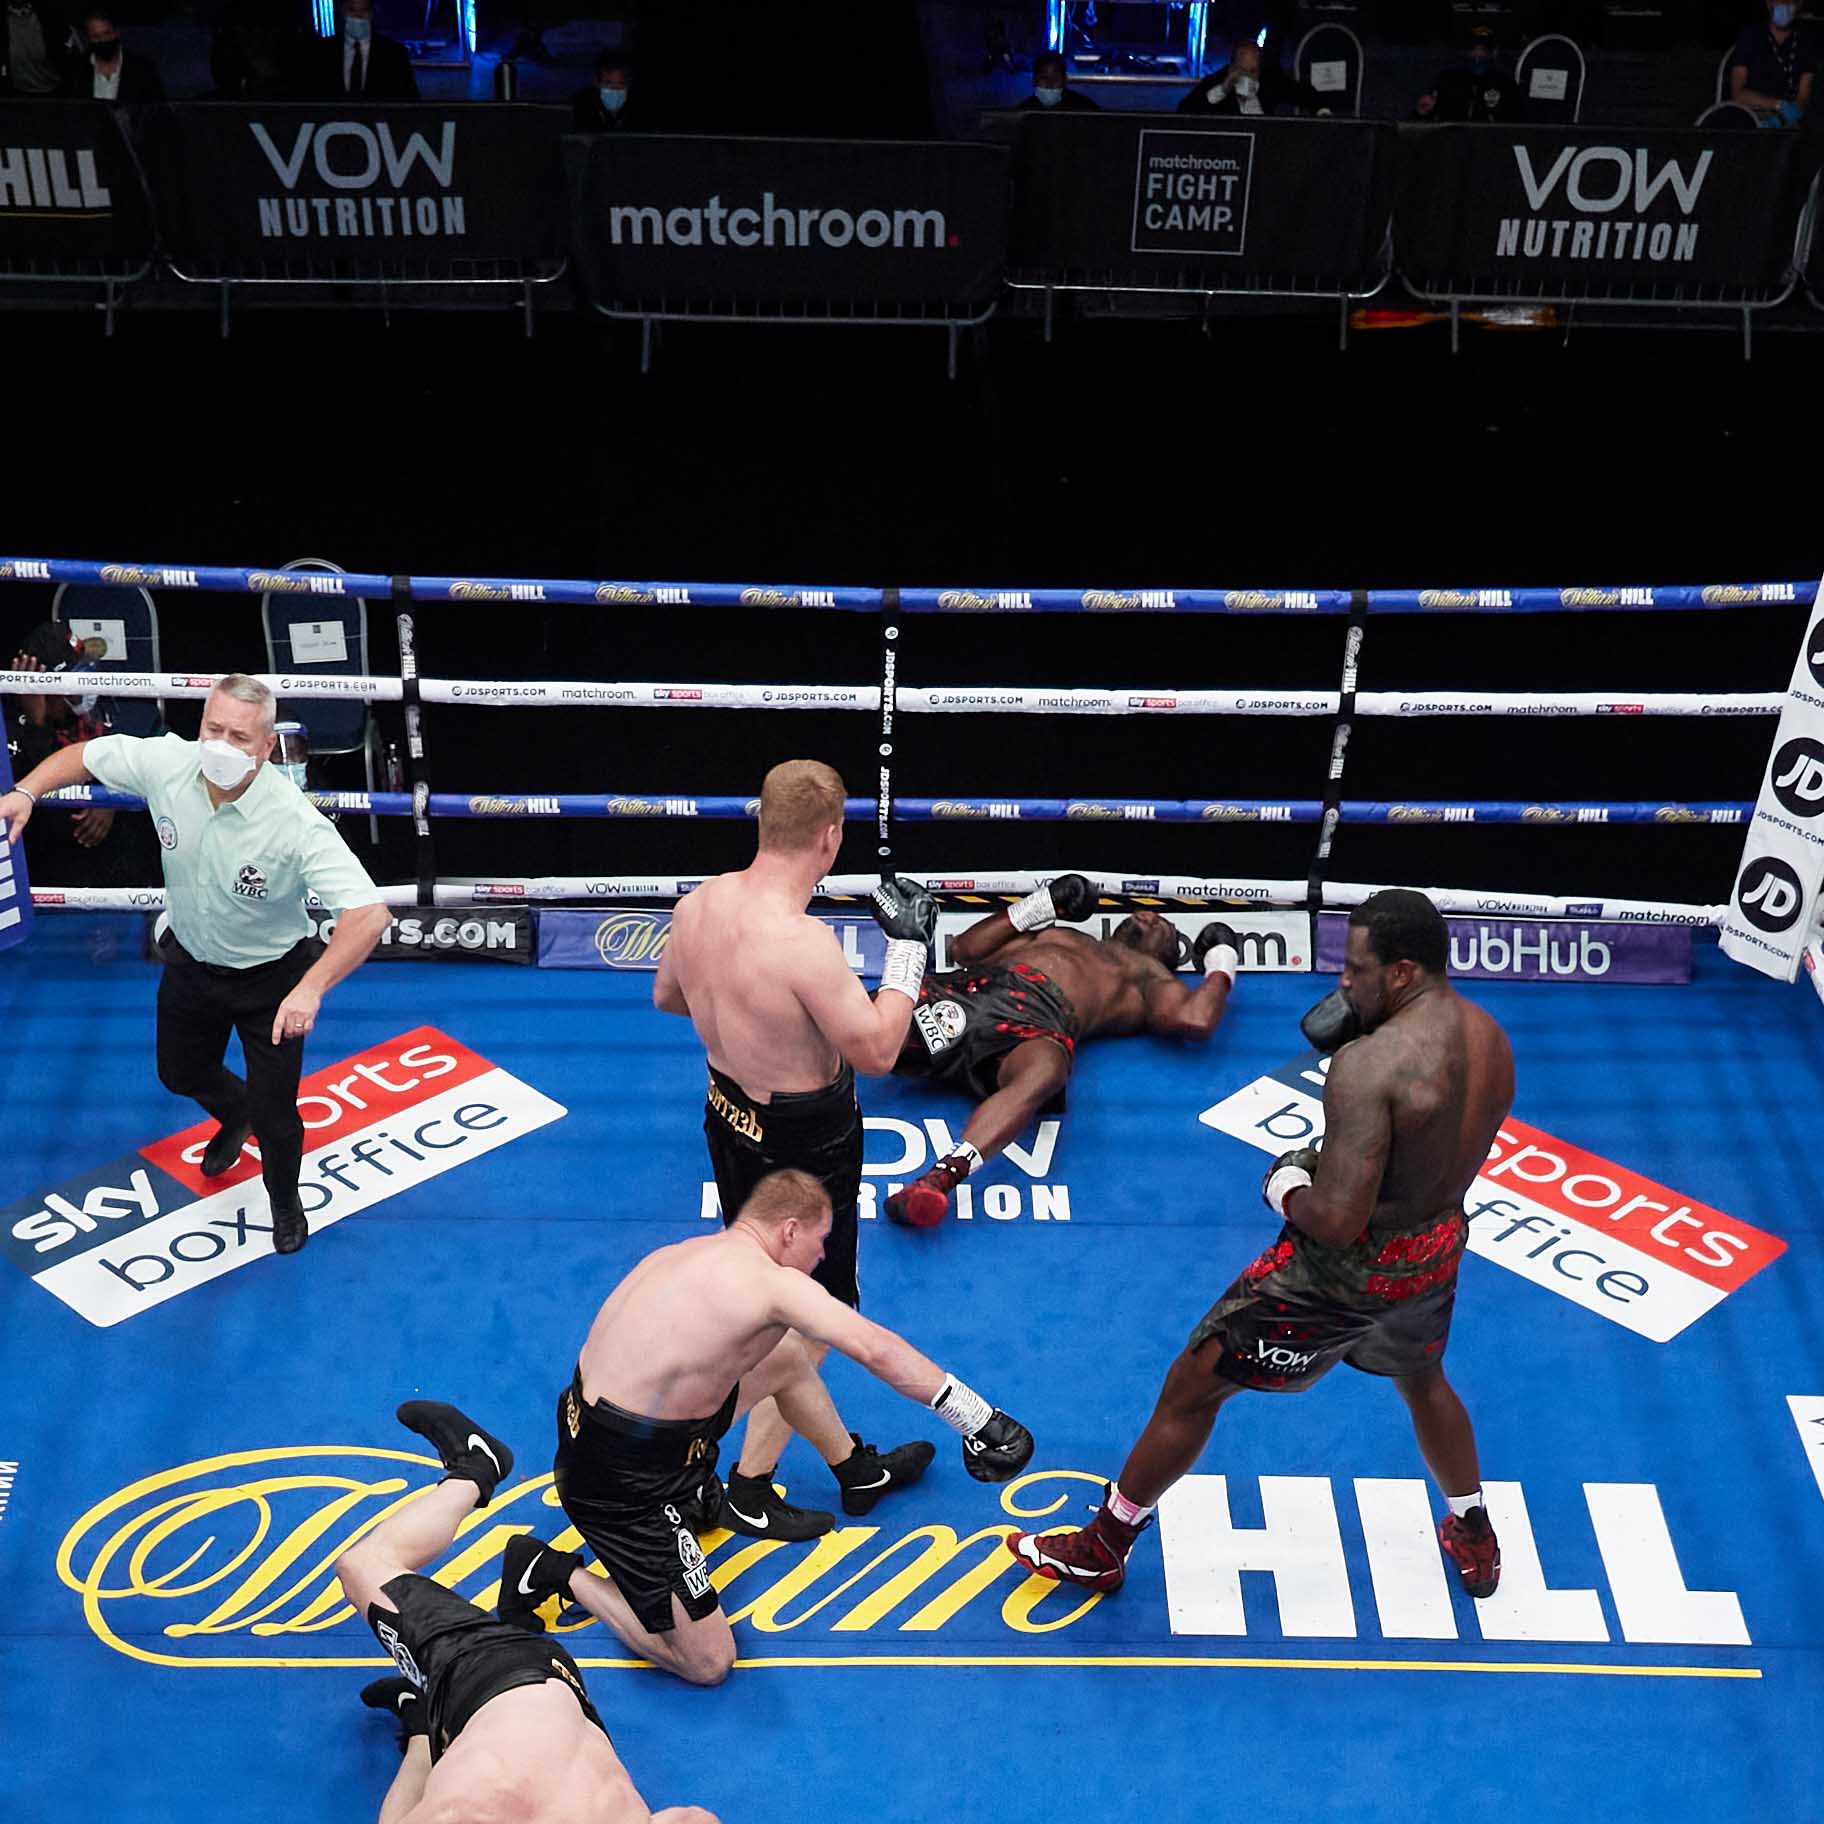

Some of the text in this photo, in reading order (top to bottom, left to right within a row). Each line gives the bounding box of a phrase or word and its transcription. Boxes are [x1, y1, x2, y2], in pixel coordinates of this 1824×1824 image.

[248, 121, 456, 190] VOW
[1148, 153, 1241, 171] matchroom.
[1145, 172, 1236, 202] FIGHT
[1511, 144, 1716, 215] VOW
[257, 195, 466, 238] NUTRITION
[609, 192, 962, 249] matchroom.
[1143, 202, 1234, 234] CAMP.
[1495, 217, 1701, 262] NUTRITION
[511, 584, 547, 601] HILL
[1284, 592, 1318, 610] HILL
[77, 674, 156, 689] matchroom.
[463, 685, 638, 700] JDSPORTS.COM matchroom.
[232, 881, 267, 900] WBC
[1176, 882, 1272, 899] matchroom.
[1444, 922, 1612, 976] ubHub
[914, 1006, 948, 1054] WBC
[181, 1044, 458, 1172] sorts
[11, 1168, 159, 1254] sky
[99, 1207, 274, 1292] box
[1466, 1198, 1651, 1304] ffice
[1255, 1338, 1318, 1368] VOW
[1157, 1473, 1753, 1646] HILL
